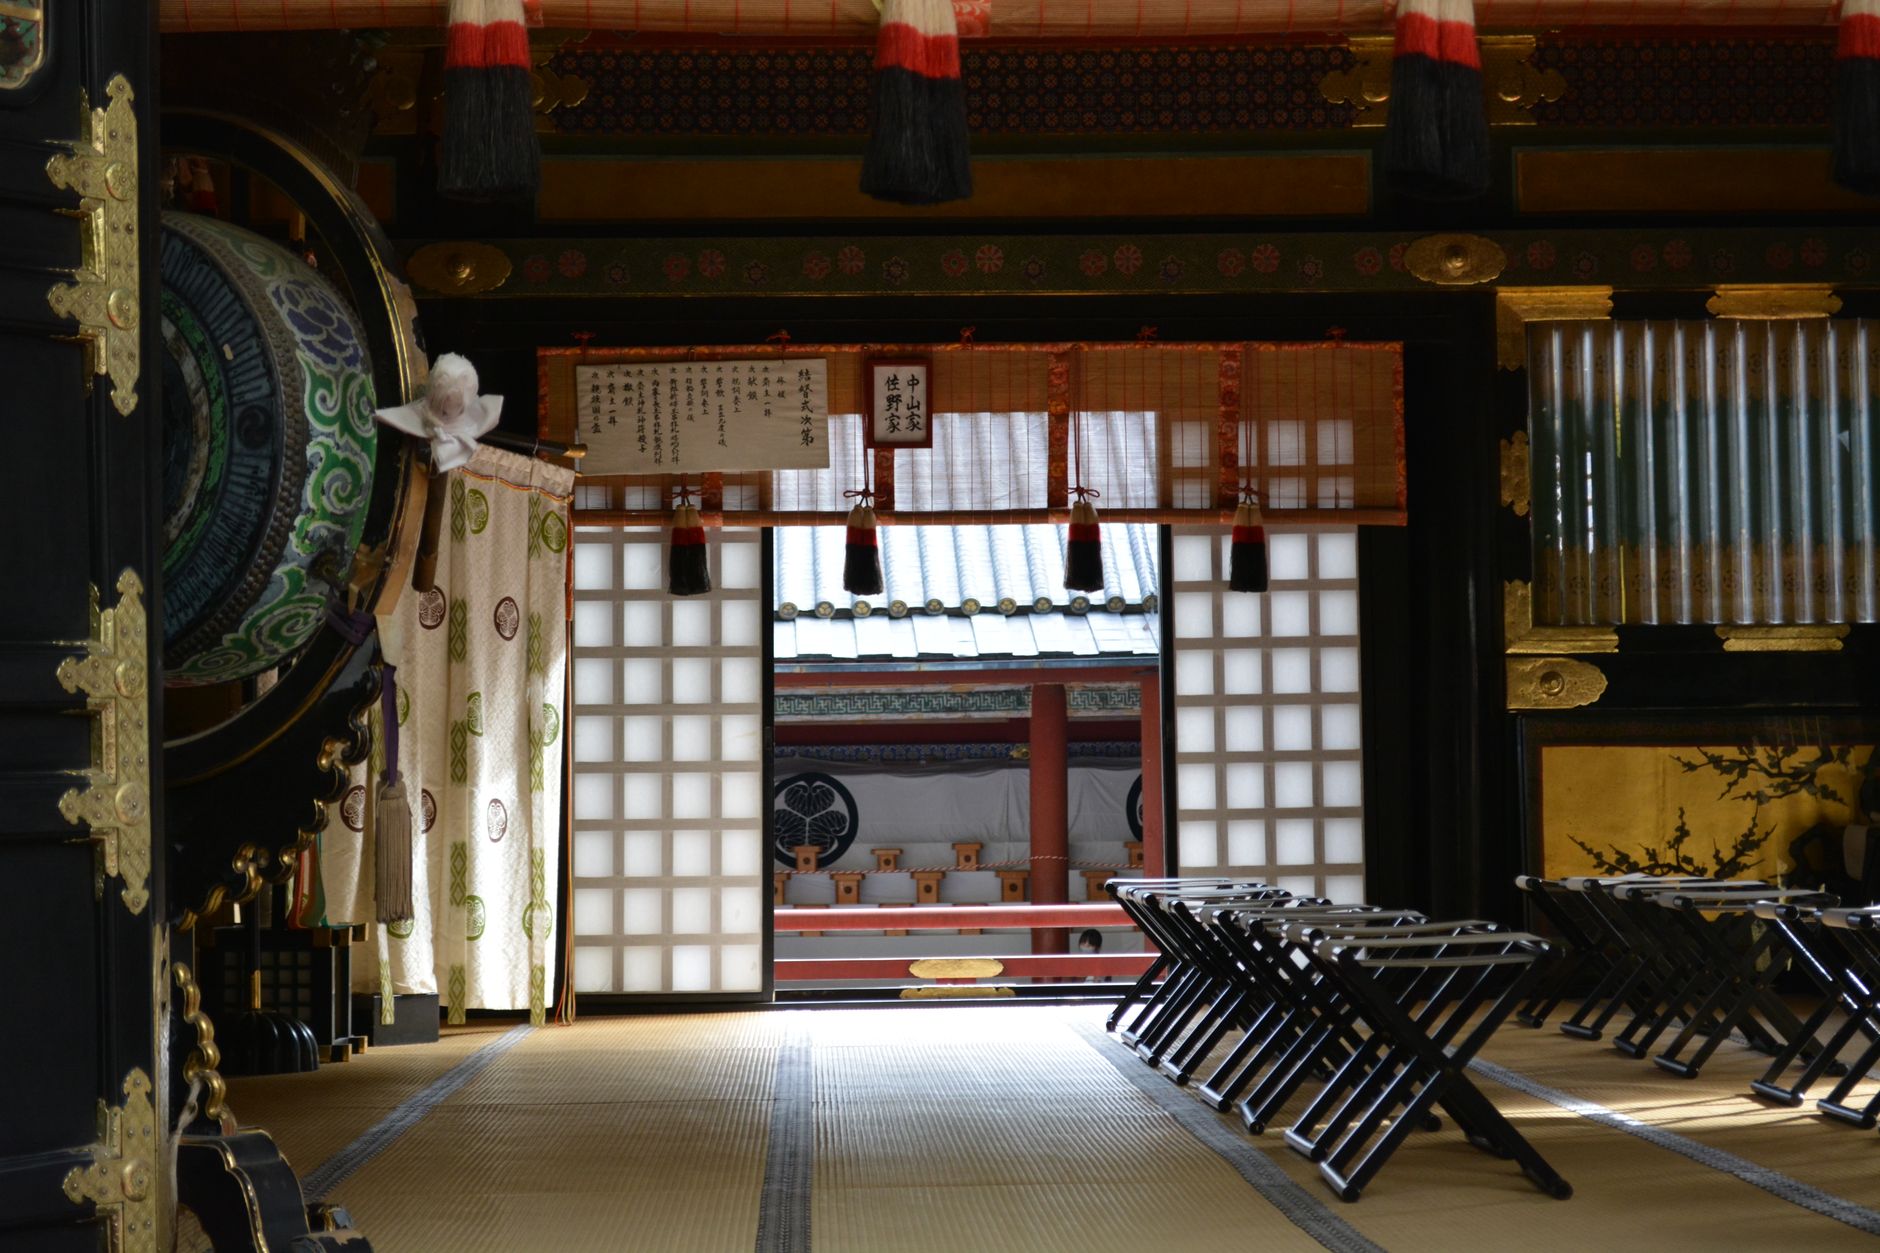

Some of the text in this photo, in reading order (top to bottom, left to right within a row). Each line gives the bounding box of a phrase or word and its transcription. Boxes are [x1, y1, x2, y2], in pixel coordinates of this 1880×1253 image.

[885, 373, 902, 433] 佐野家
[905, 373, 922, 432] 中山家
